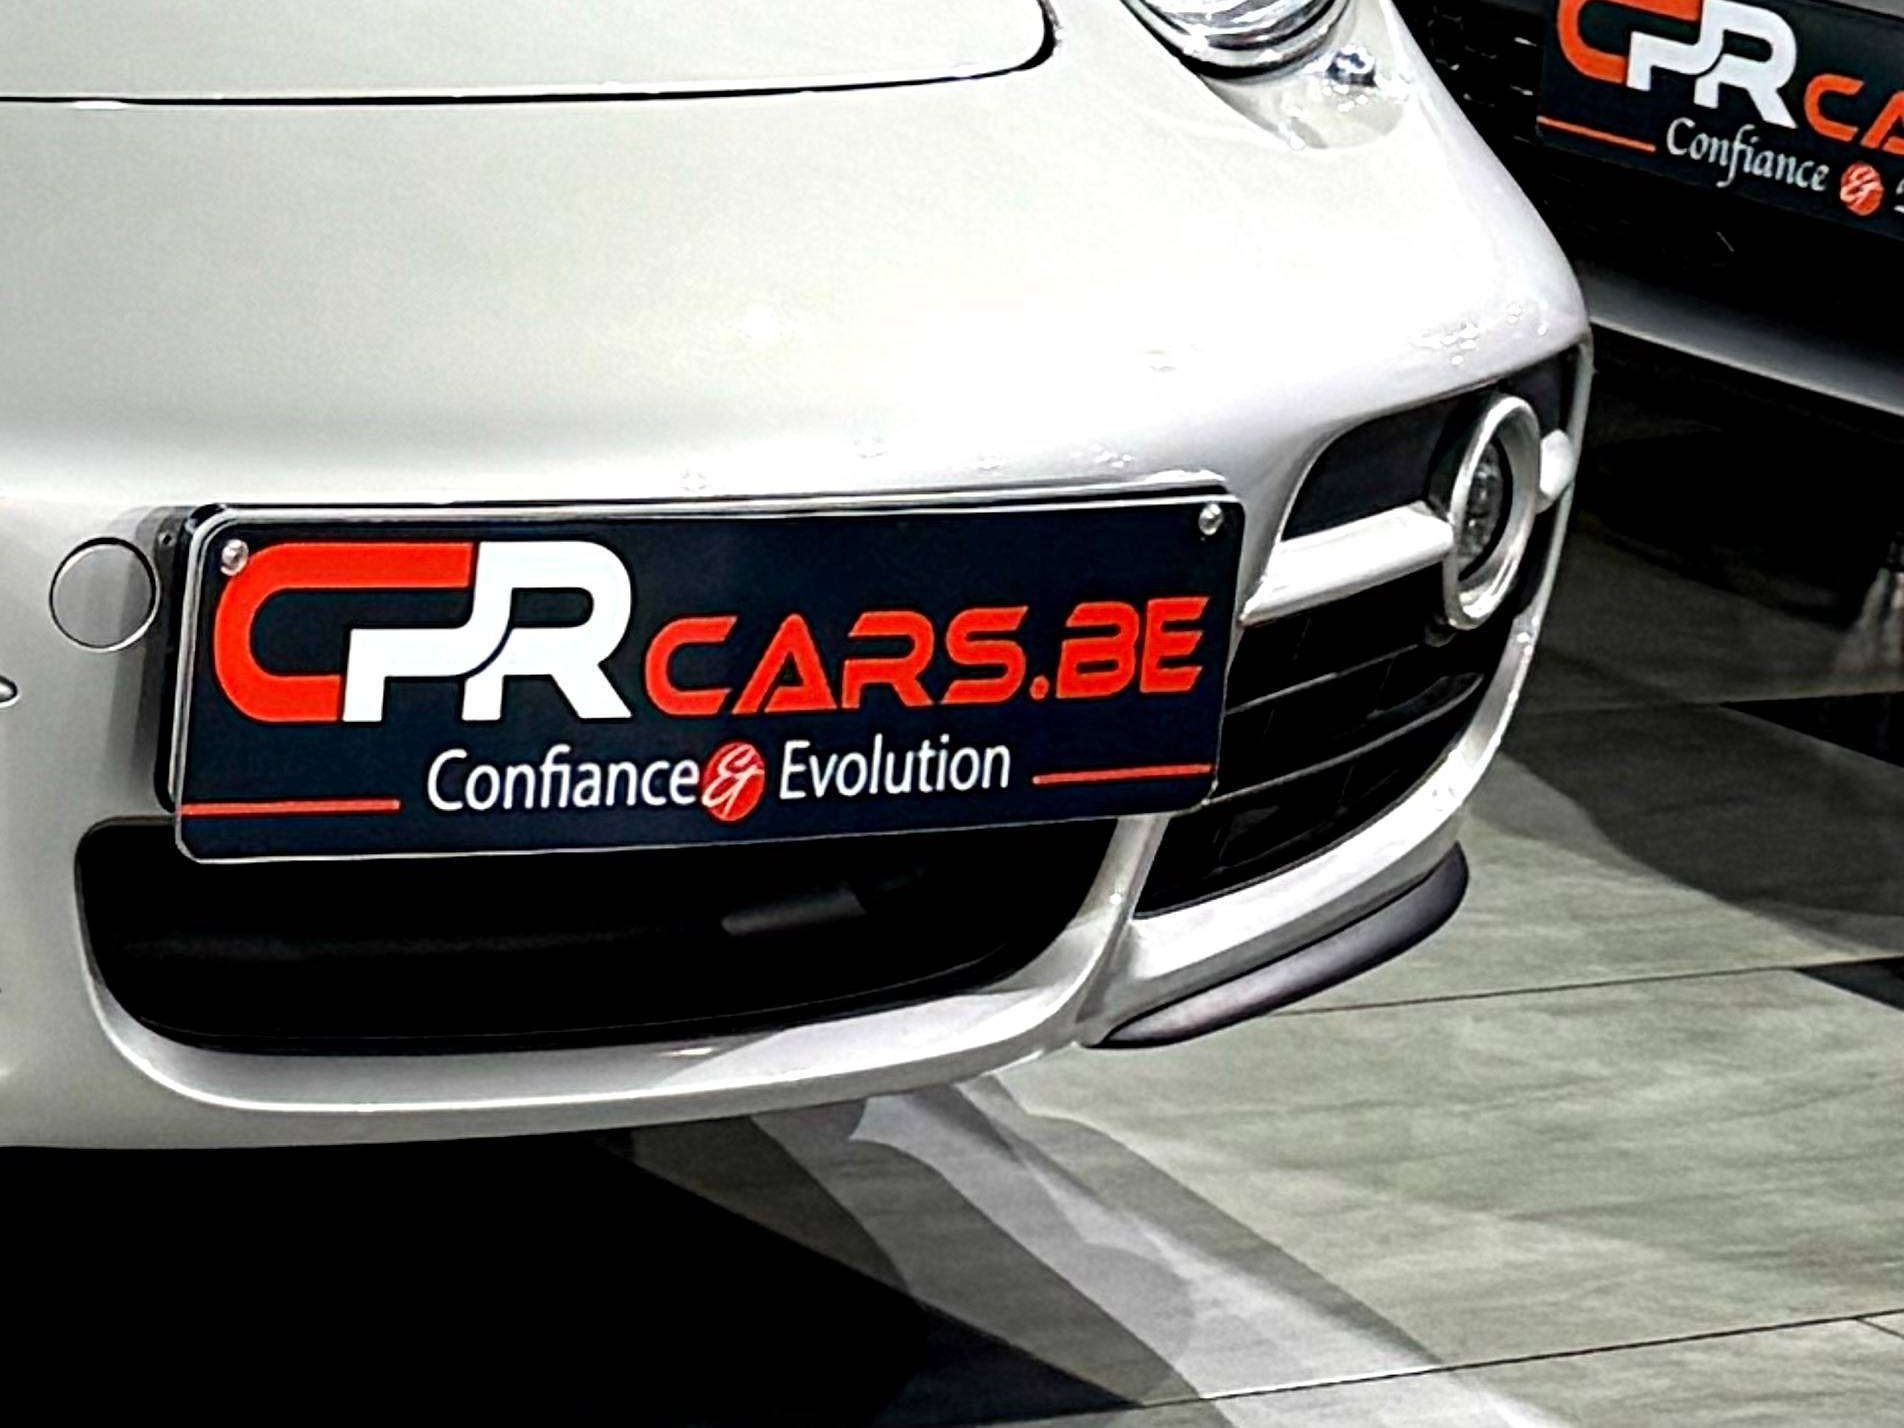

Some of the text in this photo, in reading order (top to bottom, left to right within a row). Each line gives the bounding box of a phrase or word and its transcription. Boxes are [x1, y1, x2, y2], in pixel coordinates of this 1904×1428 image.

[1666, 117, 1830, 189] Confiance
[214, 540, 1211, 723] CPR CARS.BE
[427, 743, 701, 812] Confiance
[778, 739, 1012, 804] Evolution
